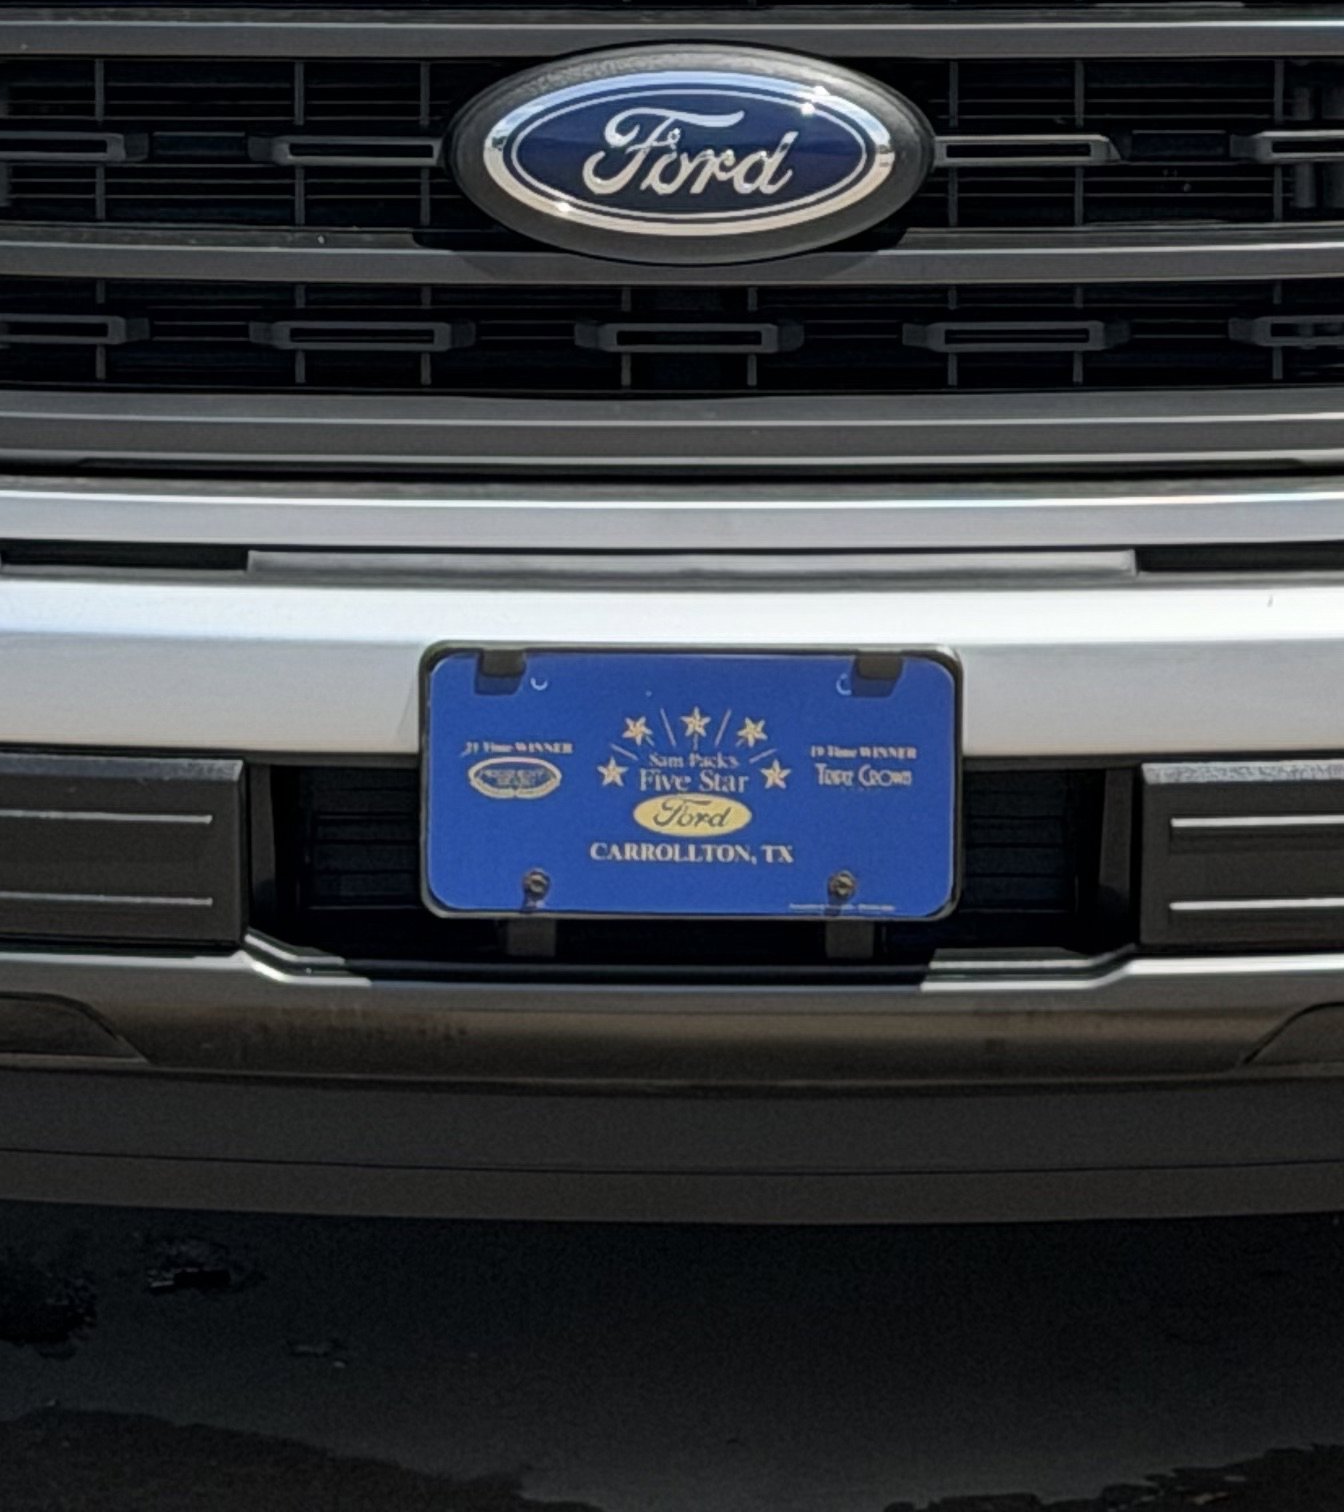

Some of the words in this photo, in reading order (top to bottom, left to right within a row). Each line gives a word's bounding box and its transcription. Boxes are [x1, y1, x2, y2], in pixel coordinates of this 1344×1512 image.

[582, 106, 800, 196] Ford
[515, 741, 573, 754] WINNER
[859, 746, 917, 759] WINNER
[649, 752, 684, 768] Sam
[639, 768, 692, 791] Five
[698, 768, 750, 793] Star
[652, 797, 732, 828] Ford
[590, 842, 757, 865] CARROLLTON,
[762, 844, 794, 864] TX
